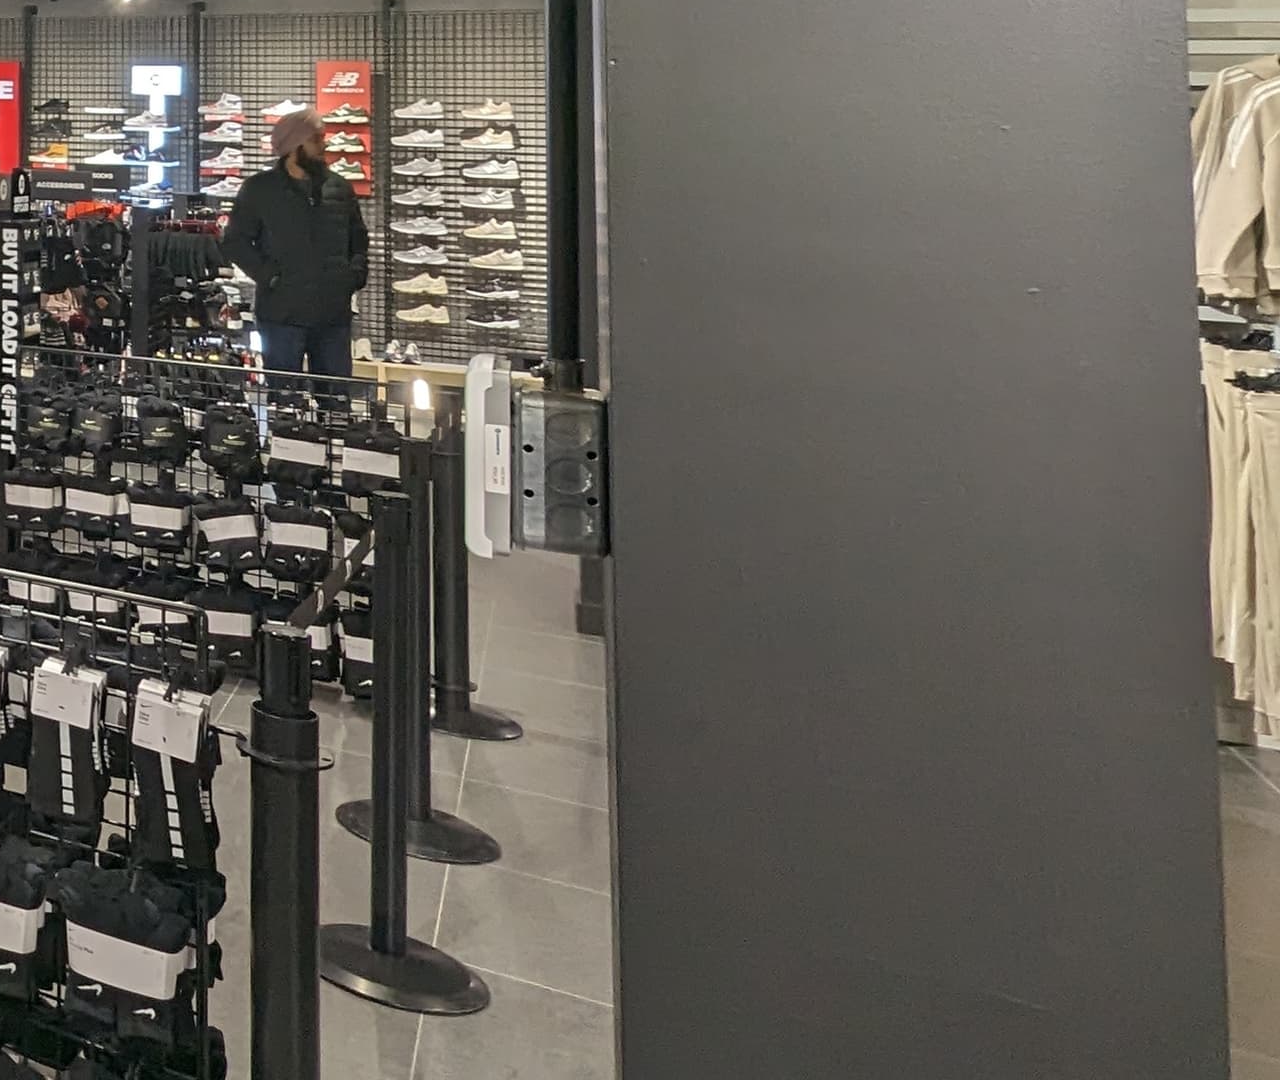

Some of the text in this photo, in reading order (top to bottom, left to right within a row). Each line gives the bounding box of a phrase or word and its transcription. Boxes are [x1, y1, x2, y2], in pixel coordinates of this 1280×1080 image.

[0, 228, 19, 455] BUY IT LOAD IT GIFT IT
